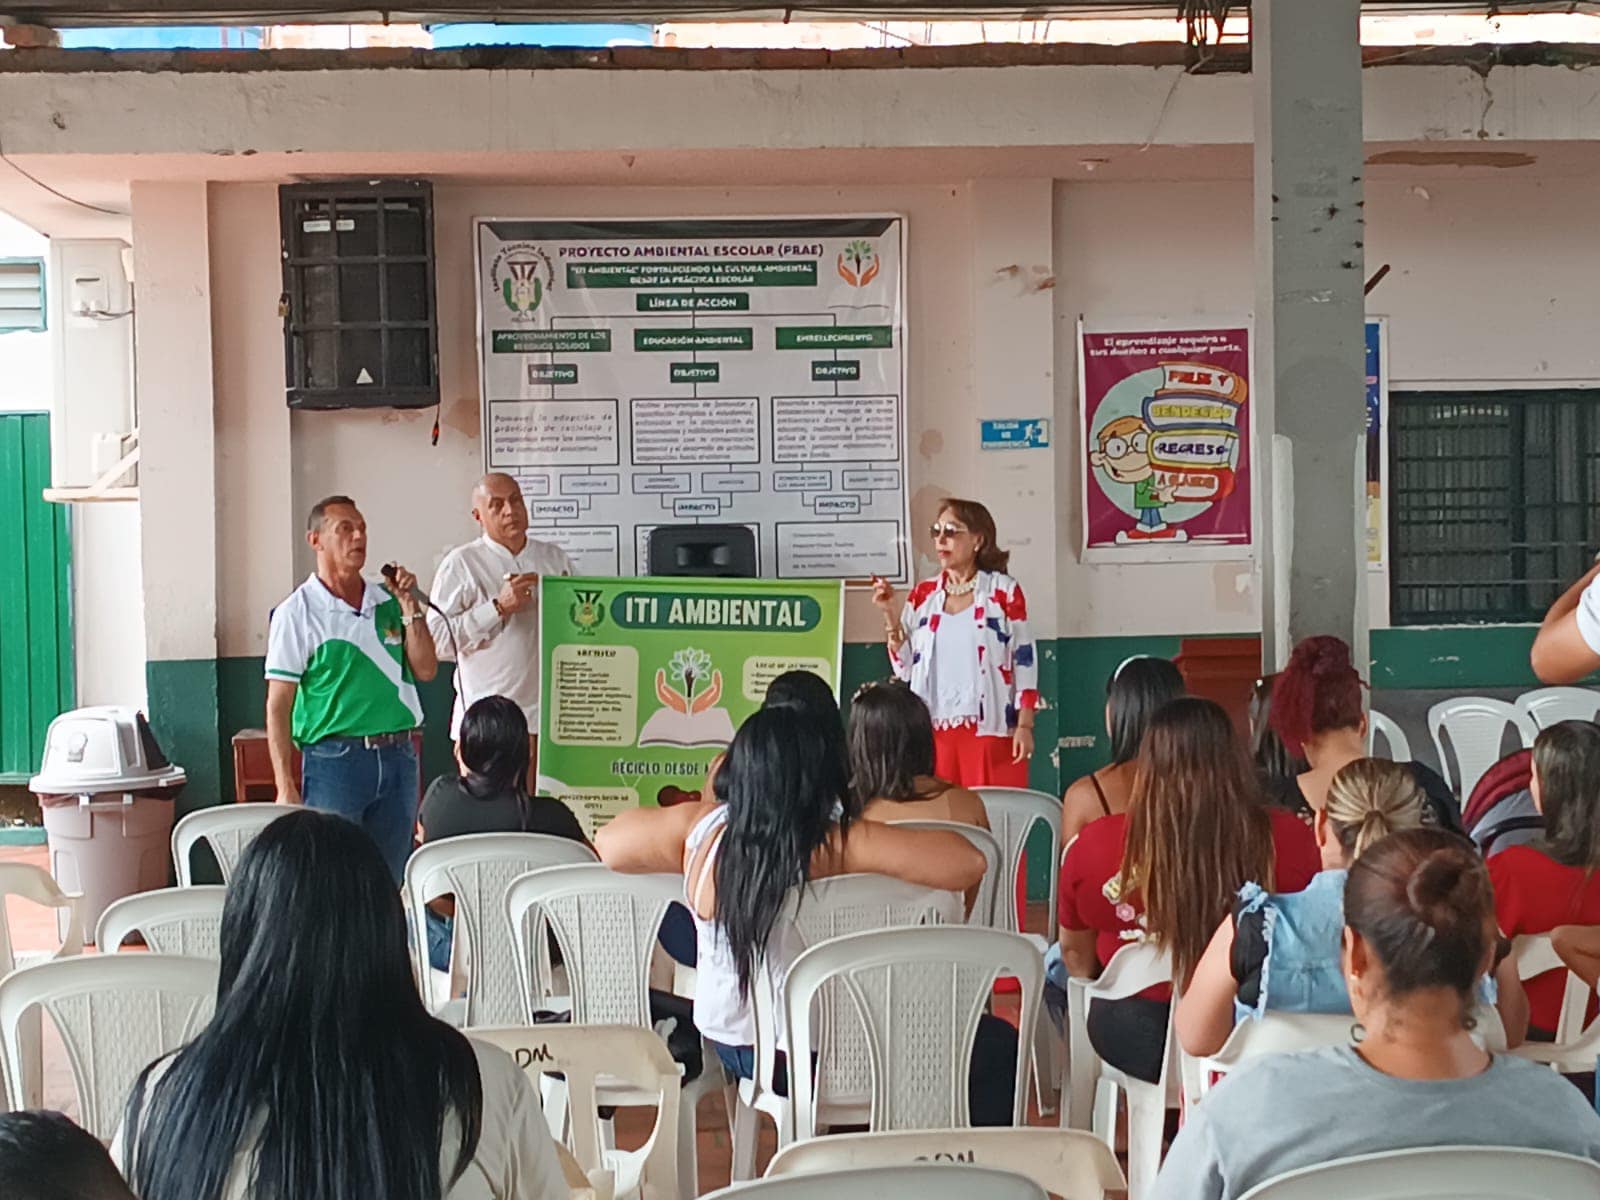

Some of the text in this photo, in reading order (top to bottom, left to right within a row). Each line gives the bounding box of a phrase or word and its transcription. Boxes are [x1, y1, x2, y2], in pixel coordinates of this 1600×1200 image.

[559, 243, 824, 258] PROYECTO AMBIENTAL ESCOLAR (PRAE)
[649, 296, 737, 308] LÍNEA DE ACCIÓN
[1218, 374, 1230, 386] Y
[626, 597, 806, 627] ITI AMBIENTAL
[612, 761, 661, 775] RECICLO
[664, 762, 699, 776] DESDE
